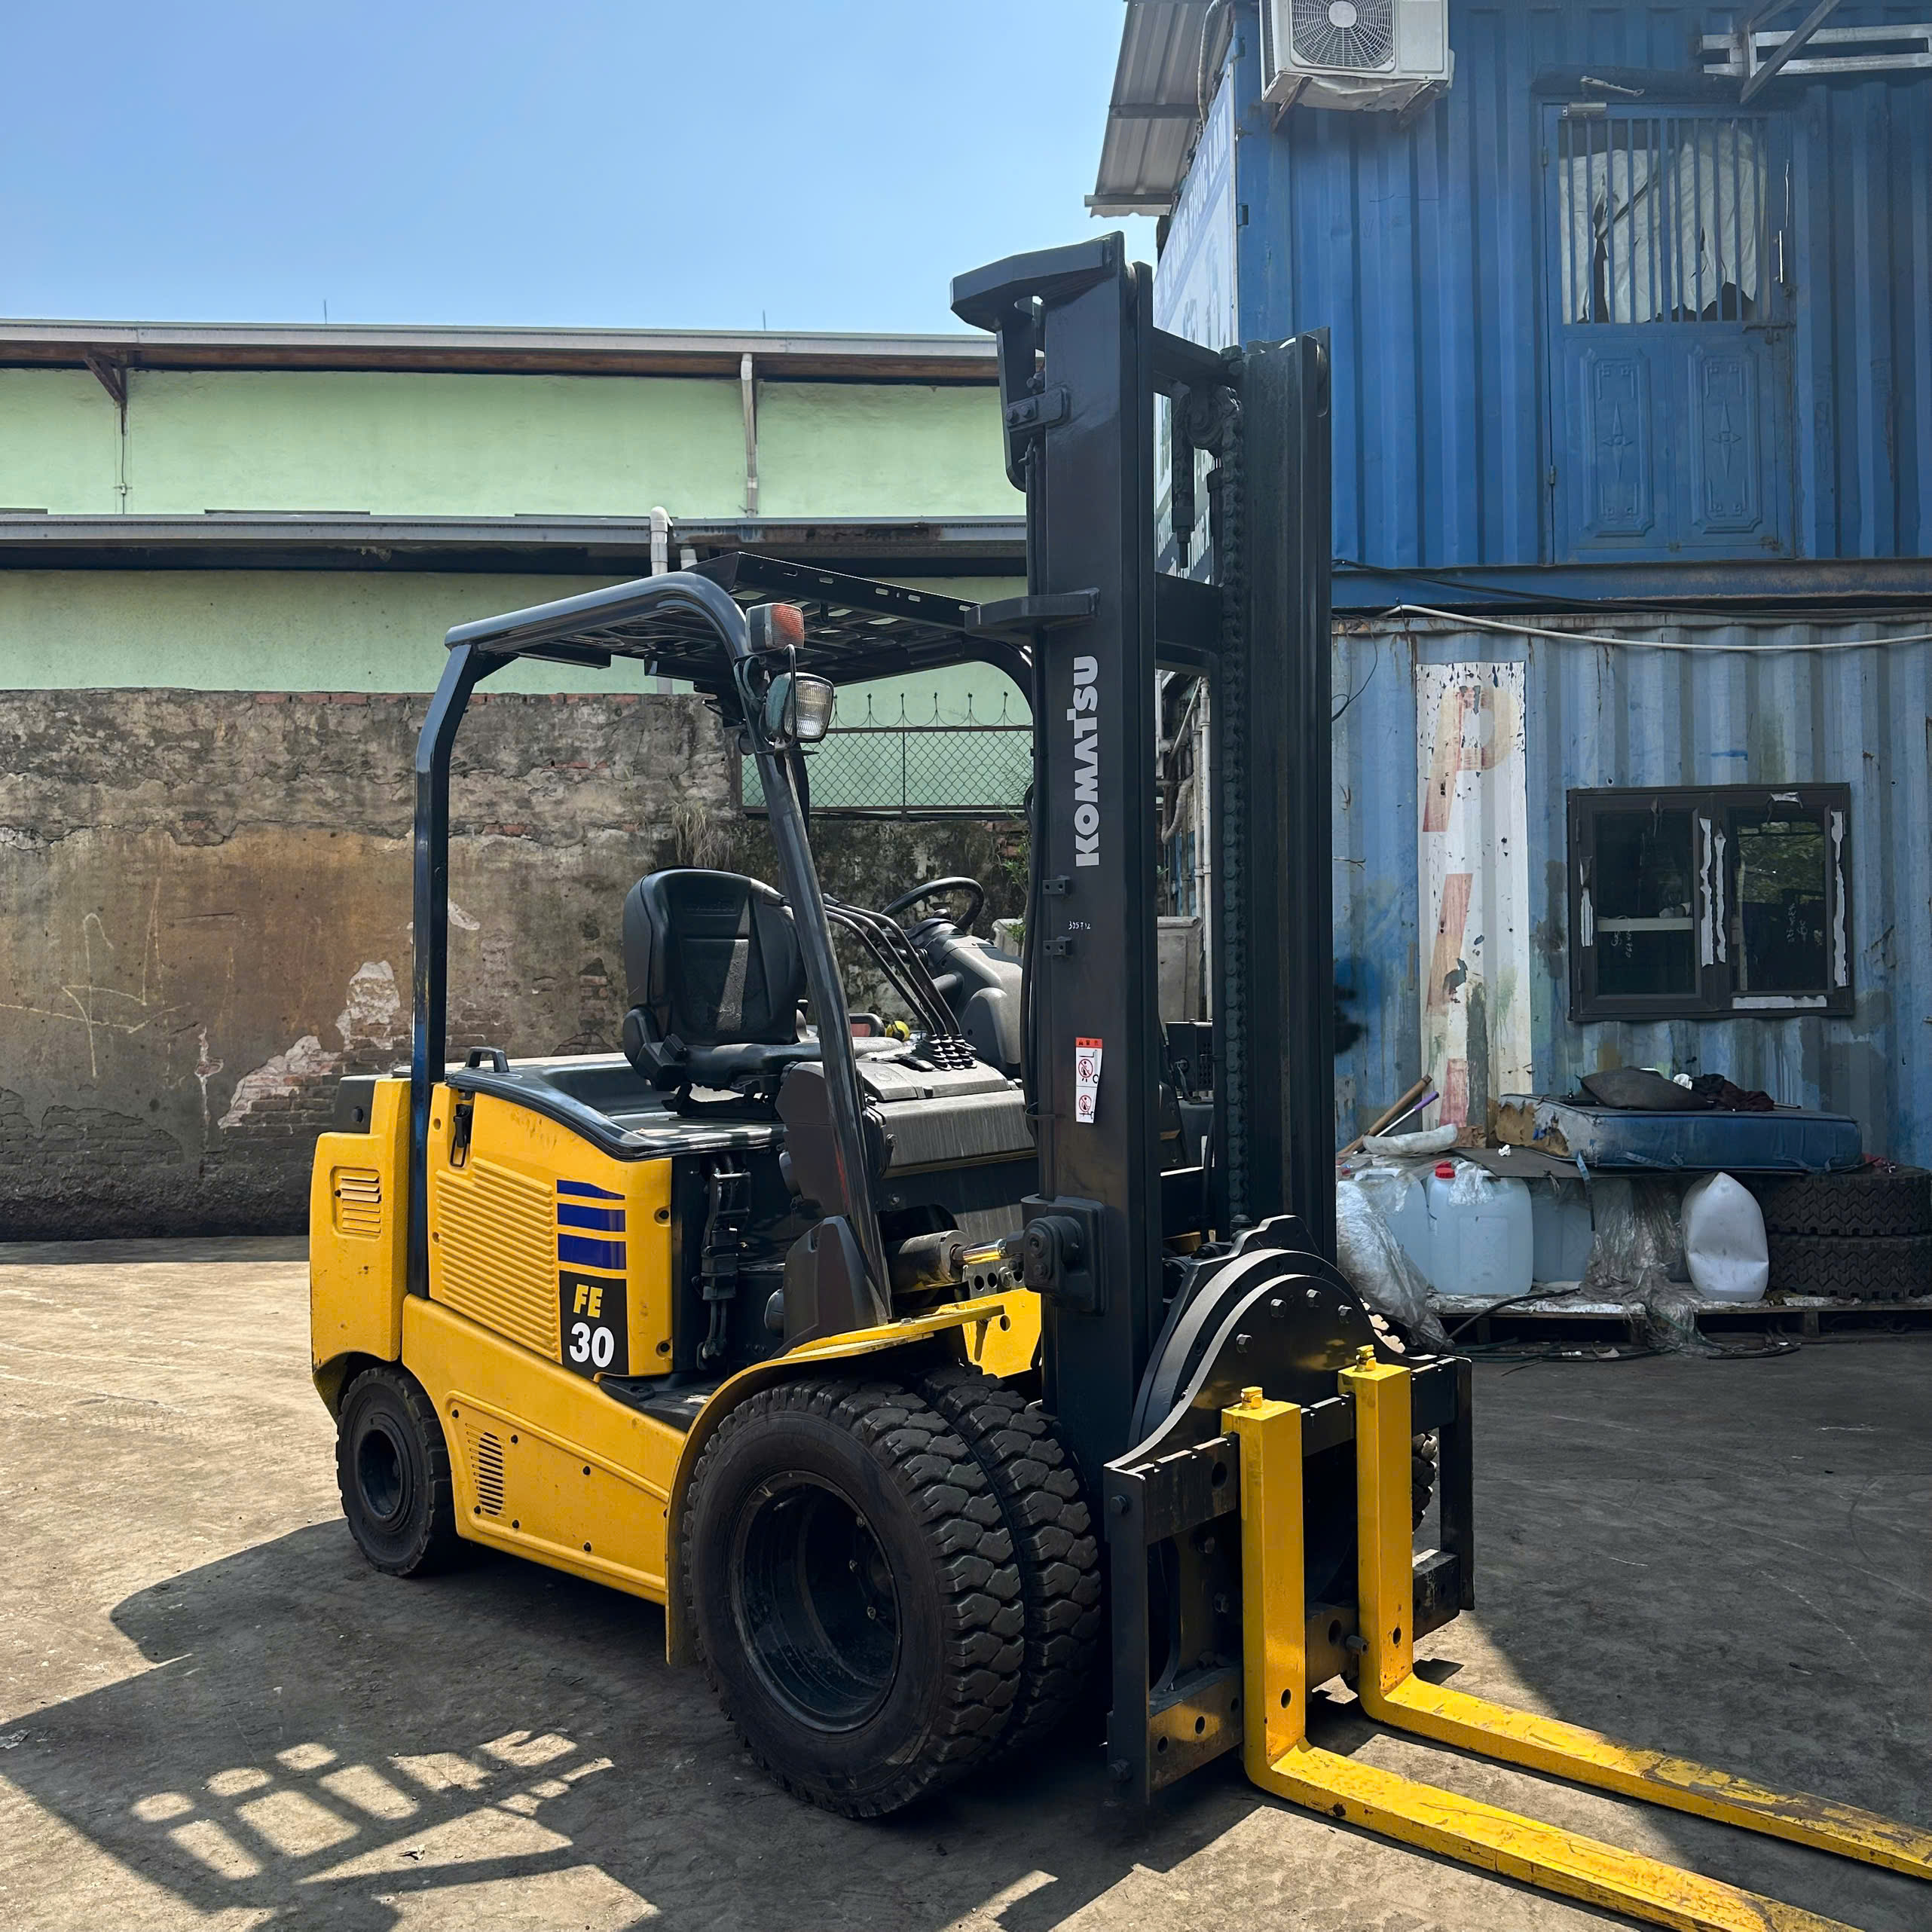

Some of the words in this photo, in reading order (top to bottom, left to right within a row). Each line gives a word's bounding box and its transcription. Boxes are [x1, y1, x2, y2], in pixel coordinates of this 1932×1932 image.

[1066, 656, 1099, 867] KOMATSU
[573, 1283, 604, 1319] FE
[569, 1322, 615, 1368] 30
